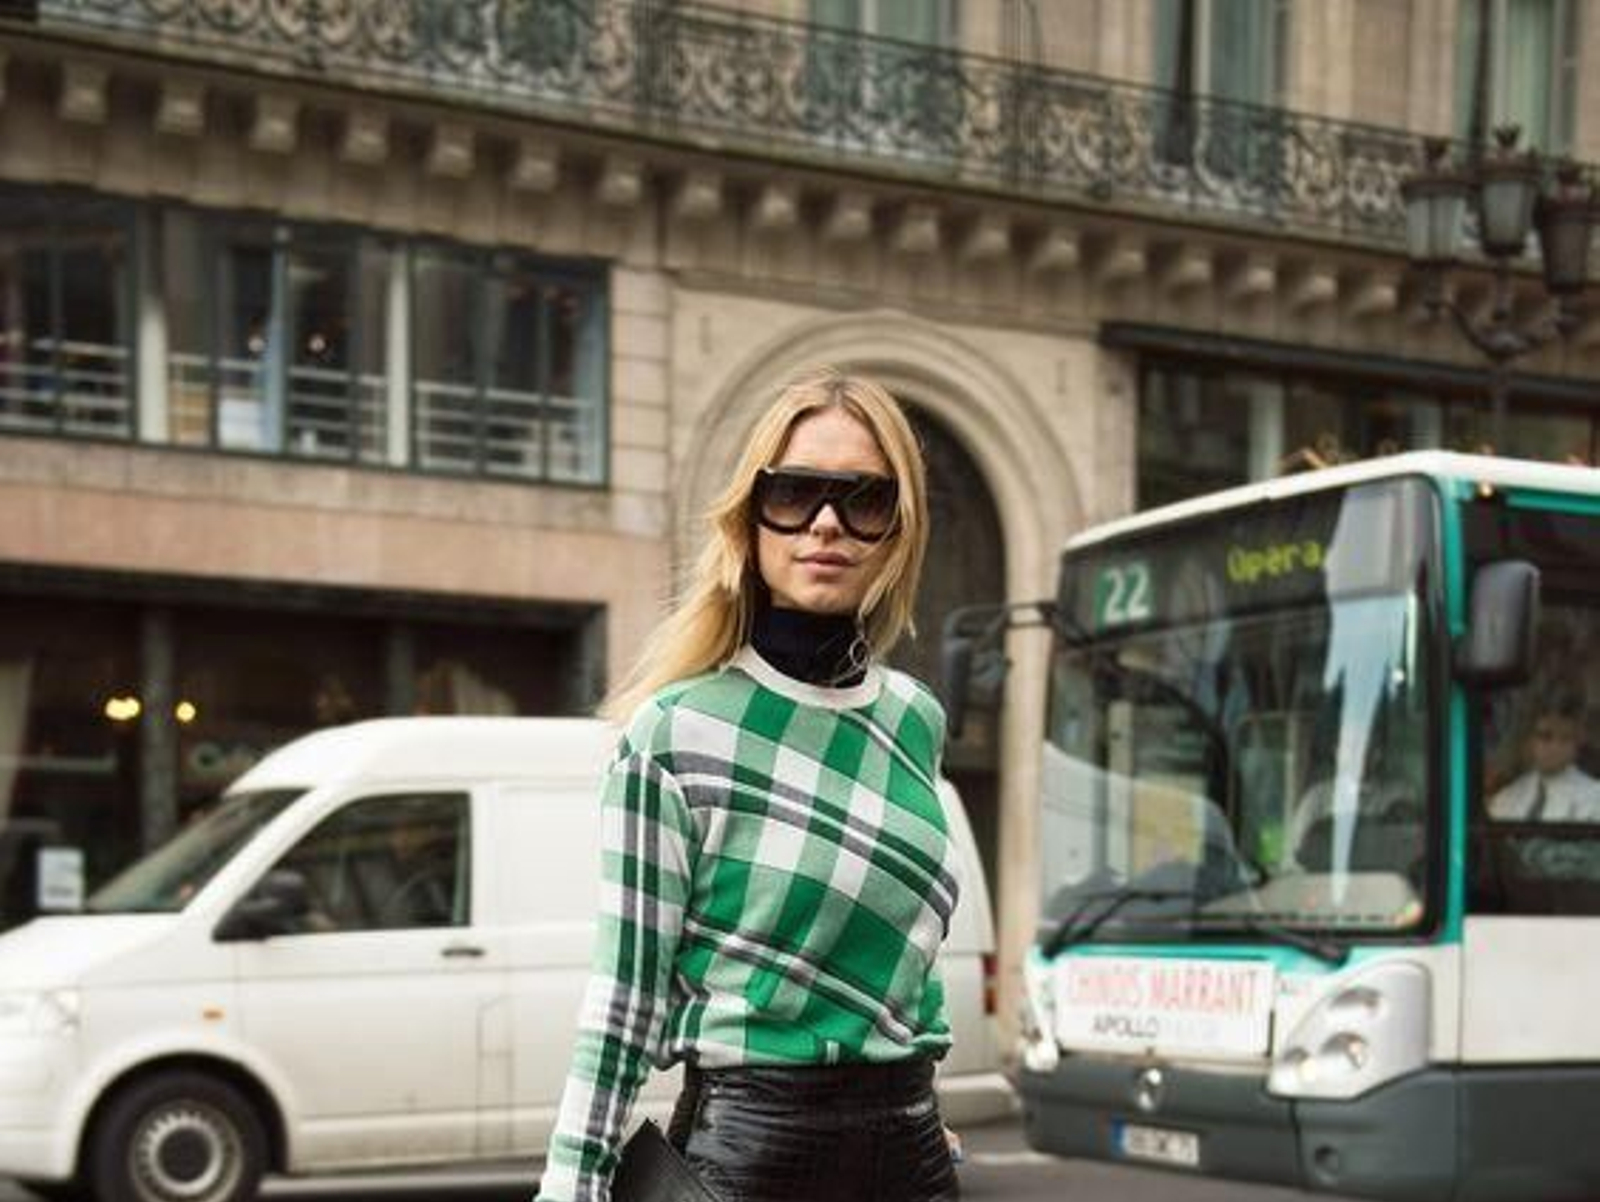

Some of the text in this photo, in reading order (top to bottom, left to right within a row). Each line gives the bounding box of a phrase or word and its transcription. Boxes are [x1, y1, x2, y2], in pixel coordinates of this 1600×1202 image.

[1104, 562, 1150, 624] 22
[1149, 967, 1258, 1016] MARRANT
[1092, 1014, 1160, 1038] APOLLO
